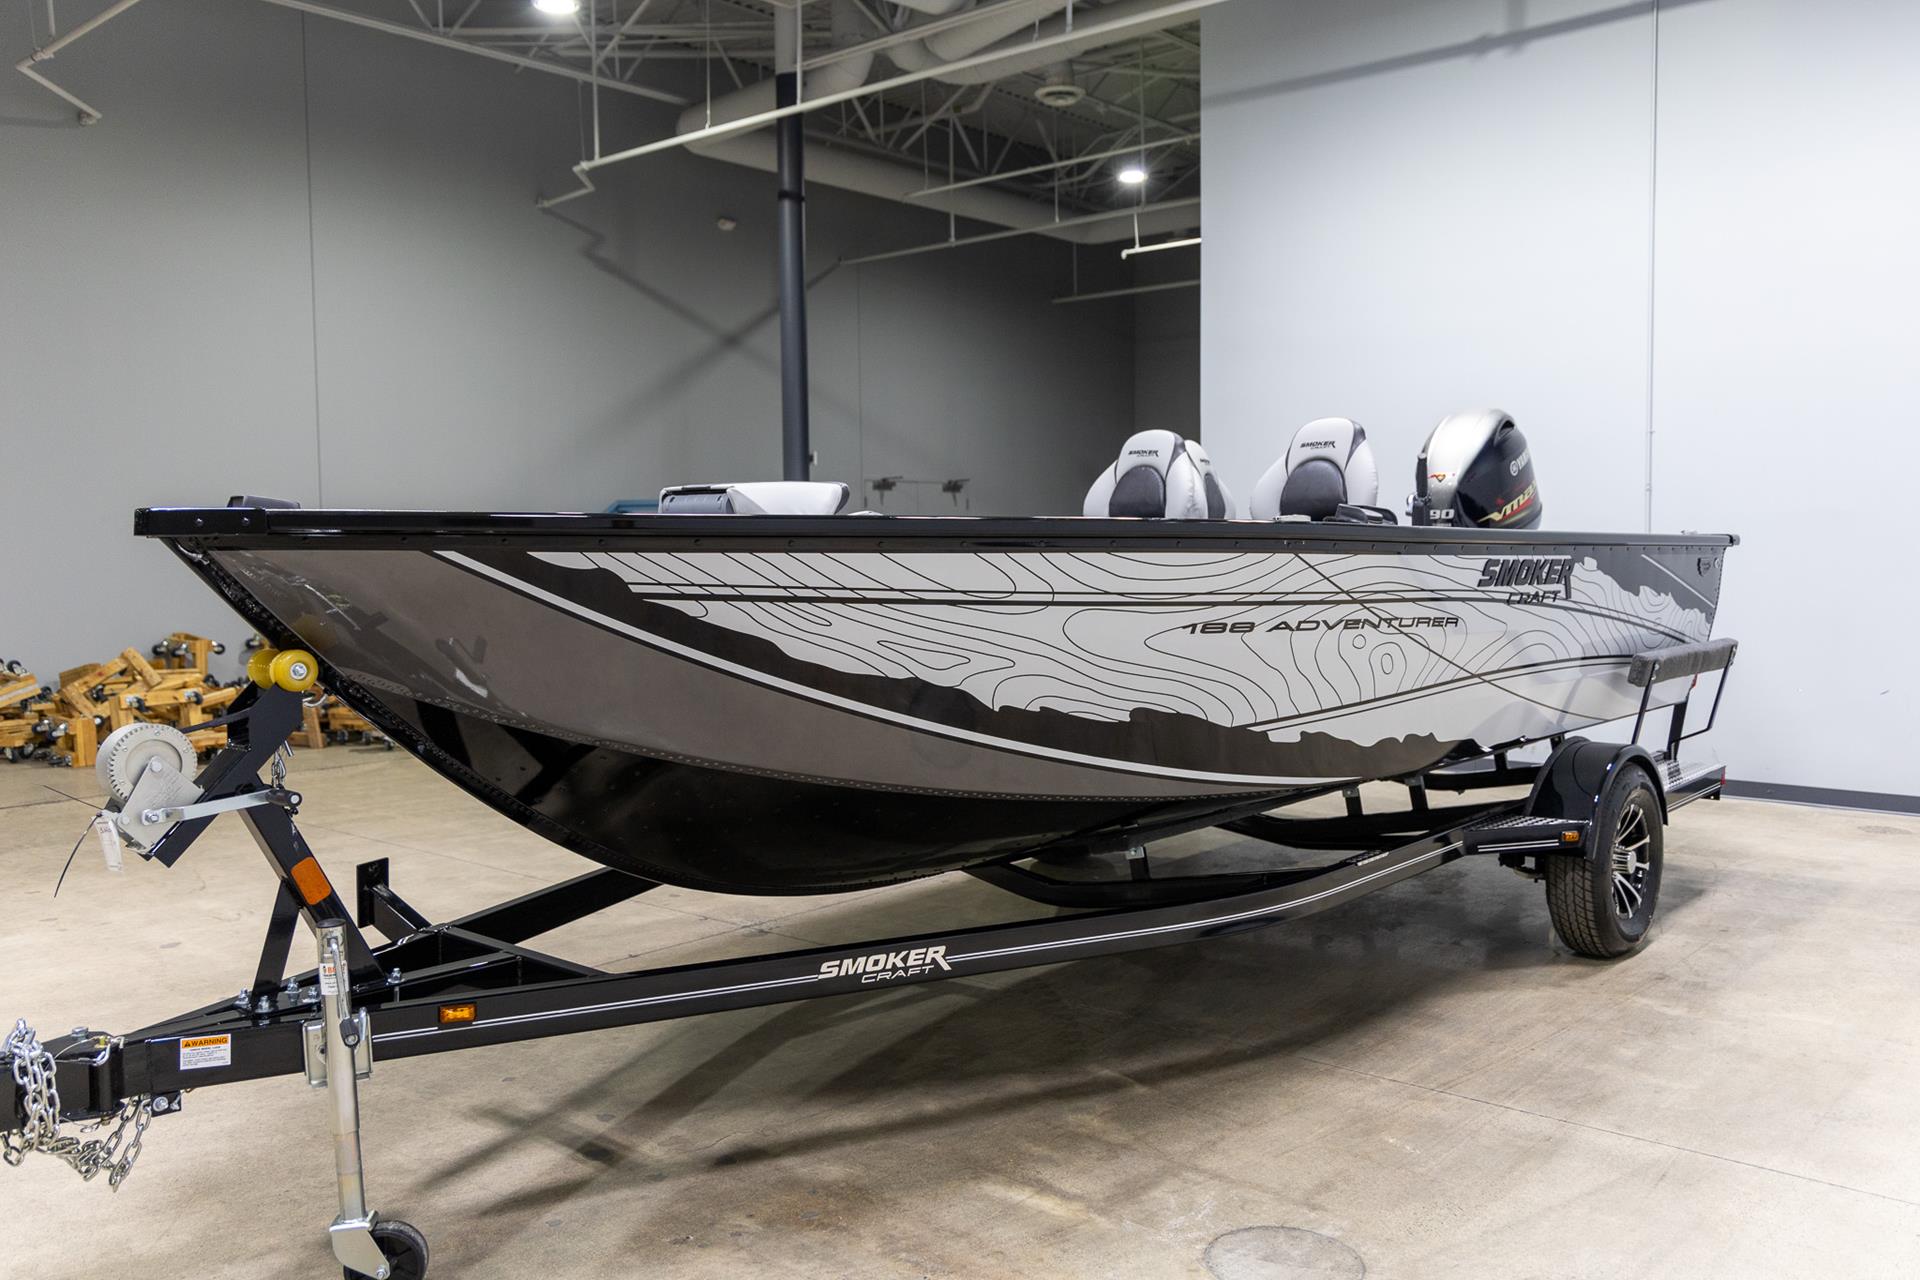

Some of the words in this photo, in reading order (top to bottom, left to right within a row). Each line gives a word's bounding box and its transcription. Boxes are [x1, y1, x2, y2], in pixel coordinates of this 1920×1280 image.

[1429, 508, 1455, 520] 90
[1477, 558, 1576, 600] SMOKER
[1506, 590, 1561, 605] CRAFT
[1181, 621, 1256, 635] 188
[1266, 616, 1459, 633] ADVENTURER
[818, 945, 952, 980] SMOKER
[861, 964, 935, 984] CRAFT
[191, 1037, 228, 1047] WARNING
